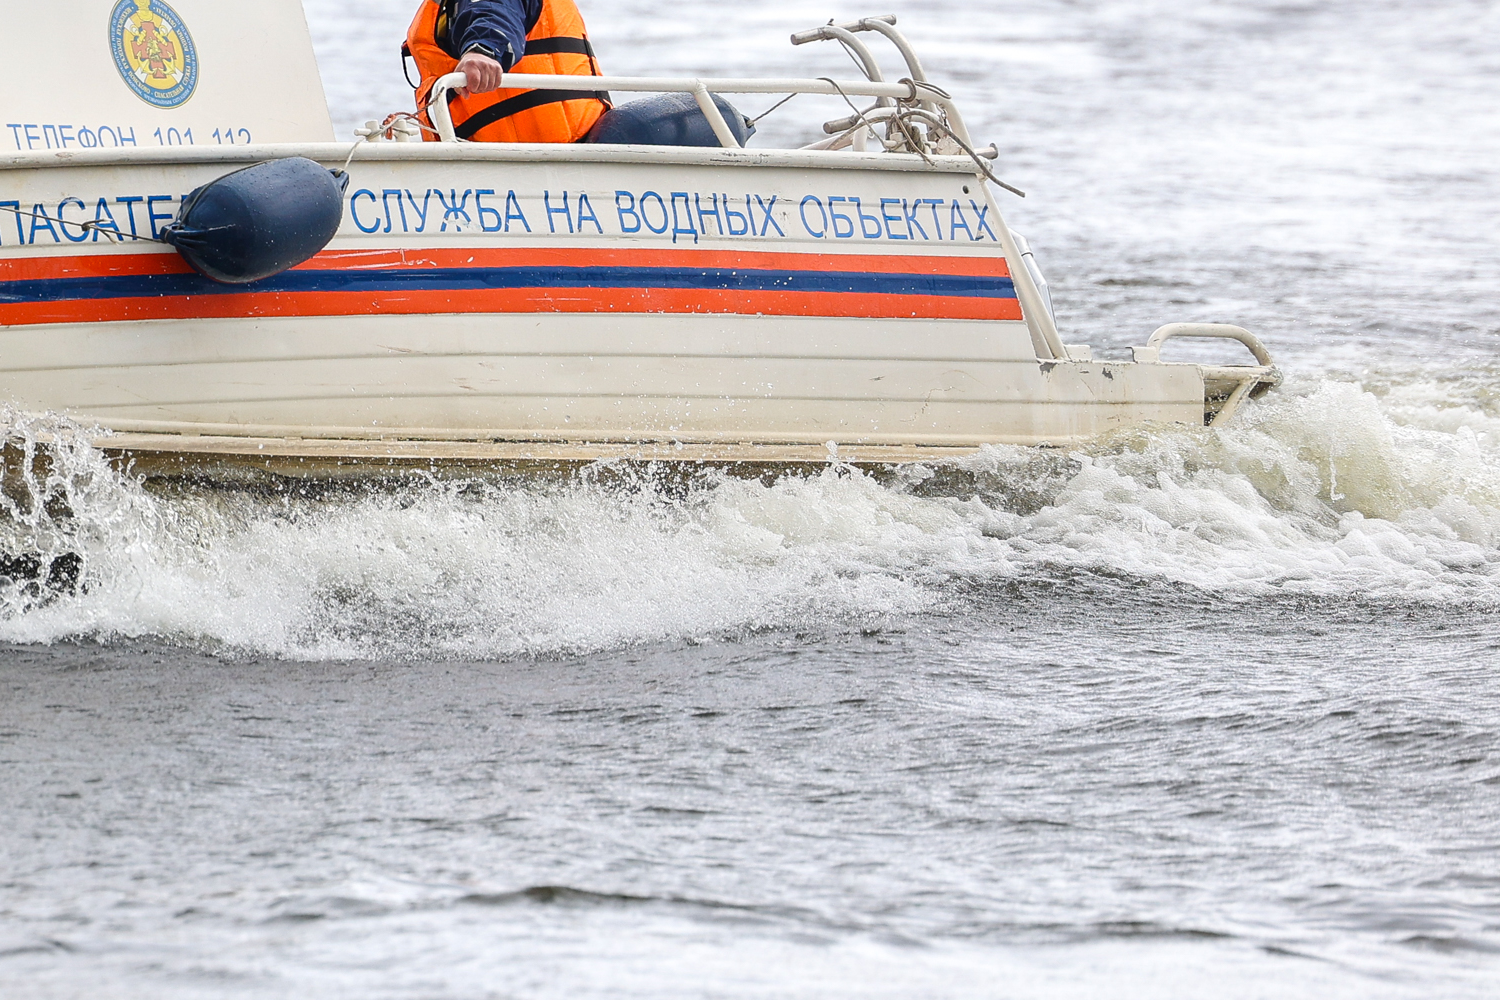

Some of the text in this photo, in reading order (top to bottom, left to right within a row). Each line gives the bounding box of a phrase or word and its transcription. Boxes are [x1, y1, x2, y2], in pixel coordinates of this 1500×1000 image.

[154, 127, 194, 146] 101
[350, 189, 531, 234] СЛУЖБА
[544, 190, 603, 234] НА
[615, 190, 784, 244] ВОДНЫХ
[800, 195, 997, 242] ОБЪЕКТАХ
